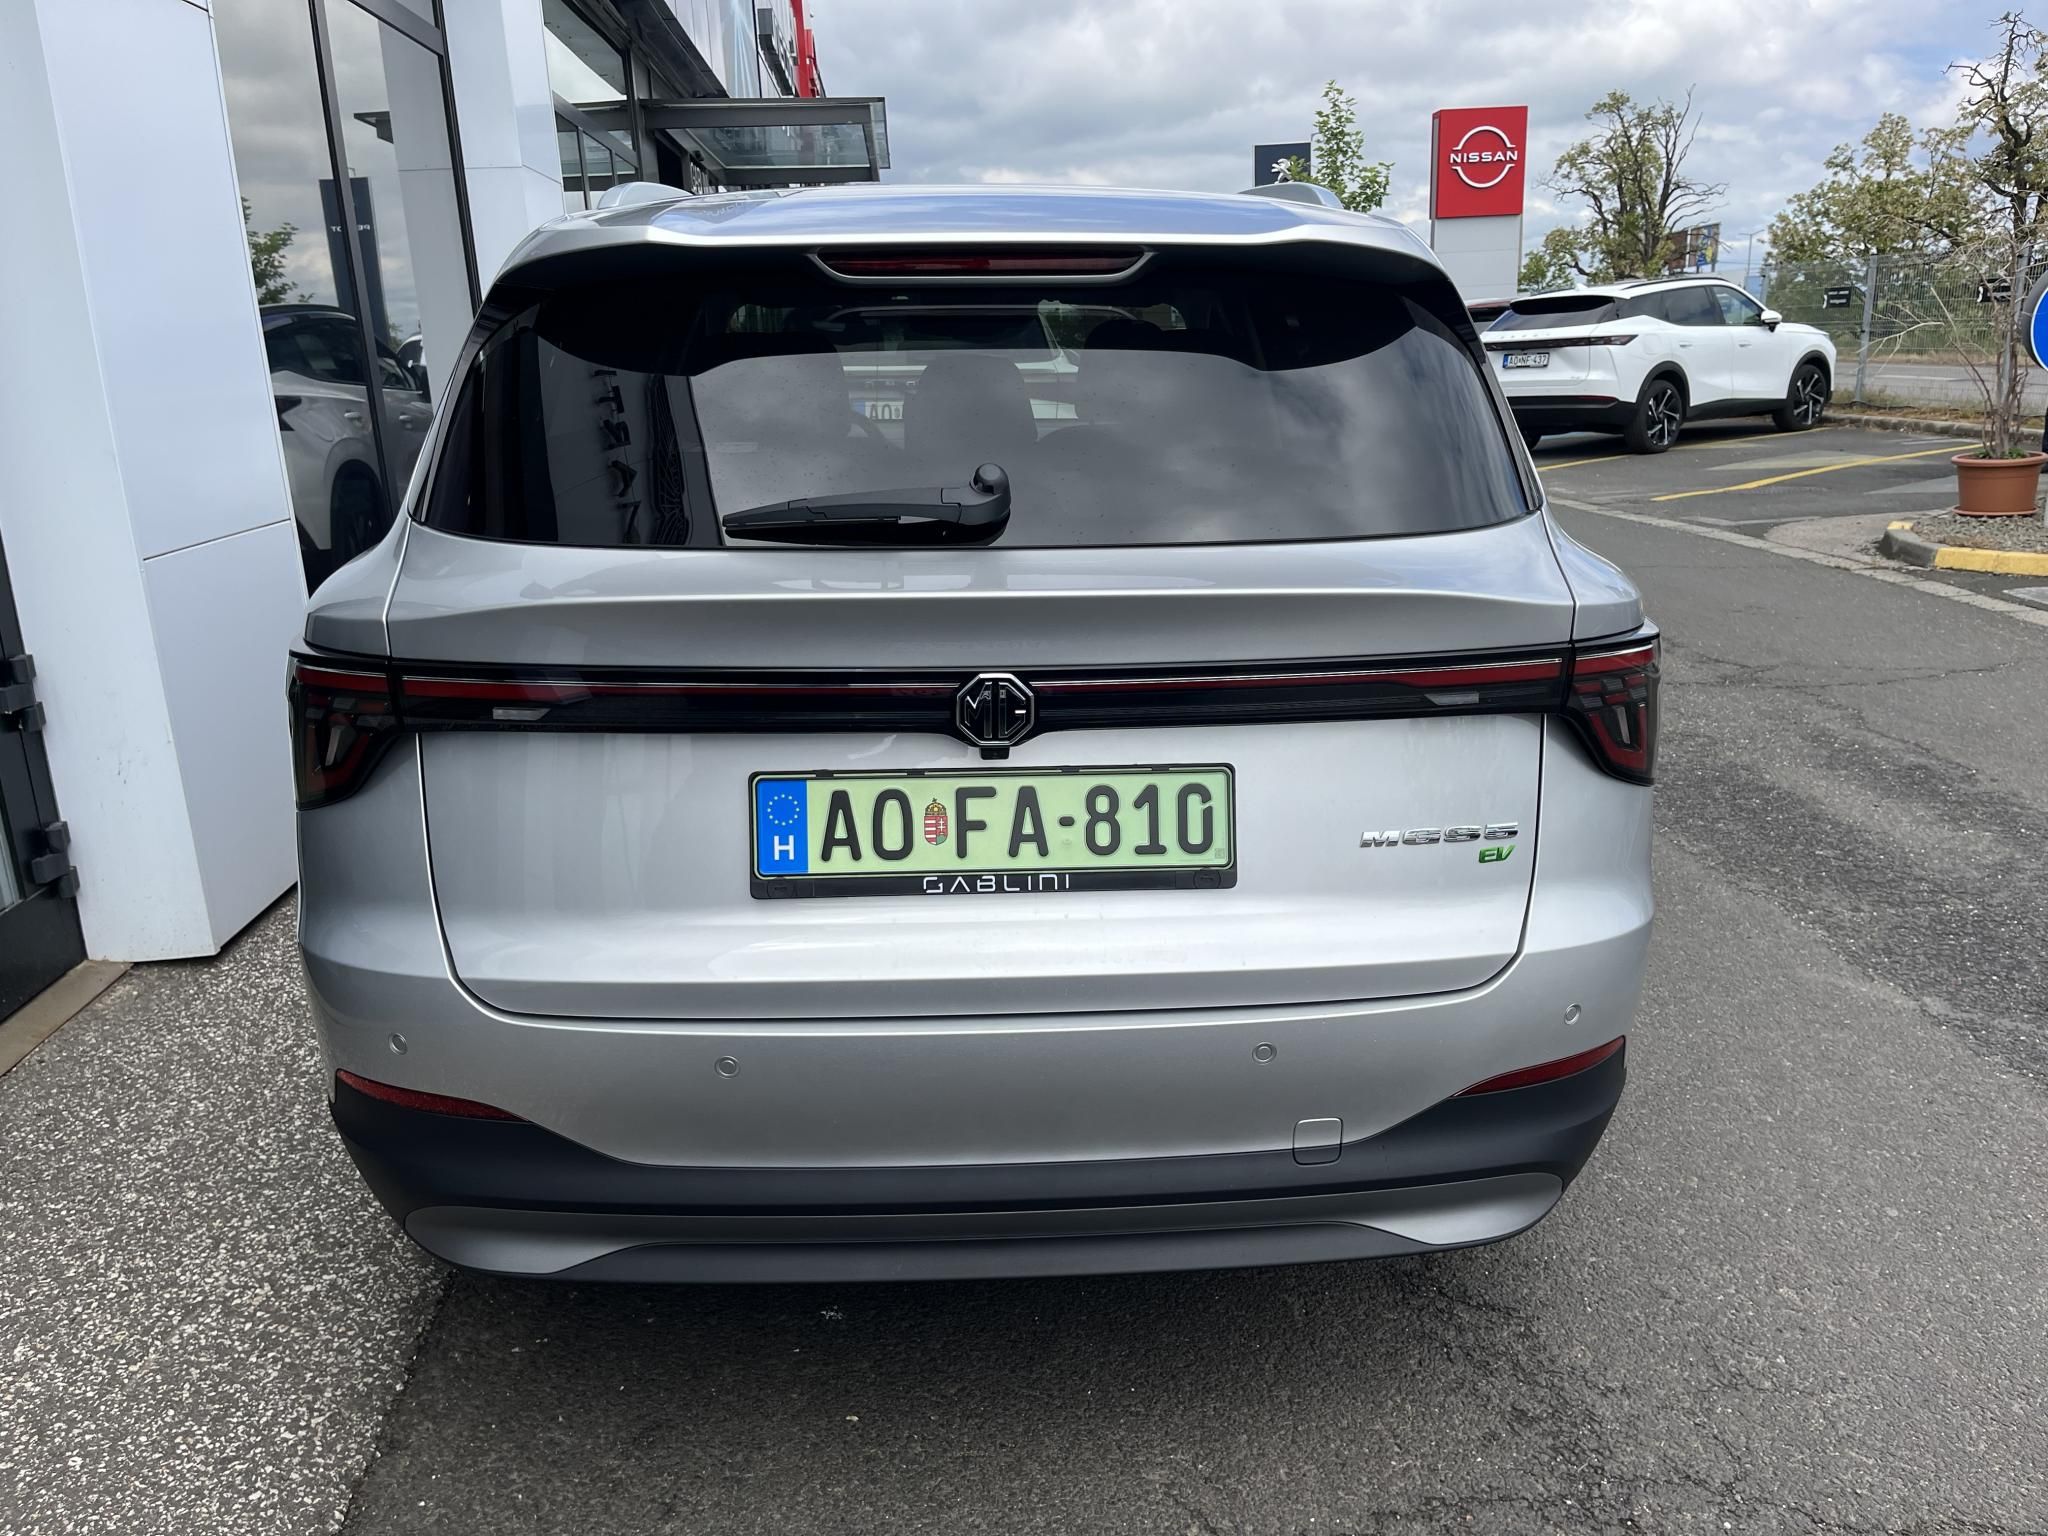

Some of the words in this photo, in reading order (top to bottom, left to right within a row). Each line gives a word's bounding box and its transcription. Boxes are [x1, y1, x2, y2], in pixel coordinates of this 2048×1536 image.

[1450, 150, 1518, 163] NISSAN
[964, 681, 1027, 739] MG
[821, 788, 914, 862] AO
[1360, 822, 1519, 848] MGS5
[774, 835, 794, 860] H
[1478, 844, 1516, 863] EV
[923, 873, 1071, 894] GABLINI
